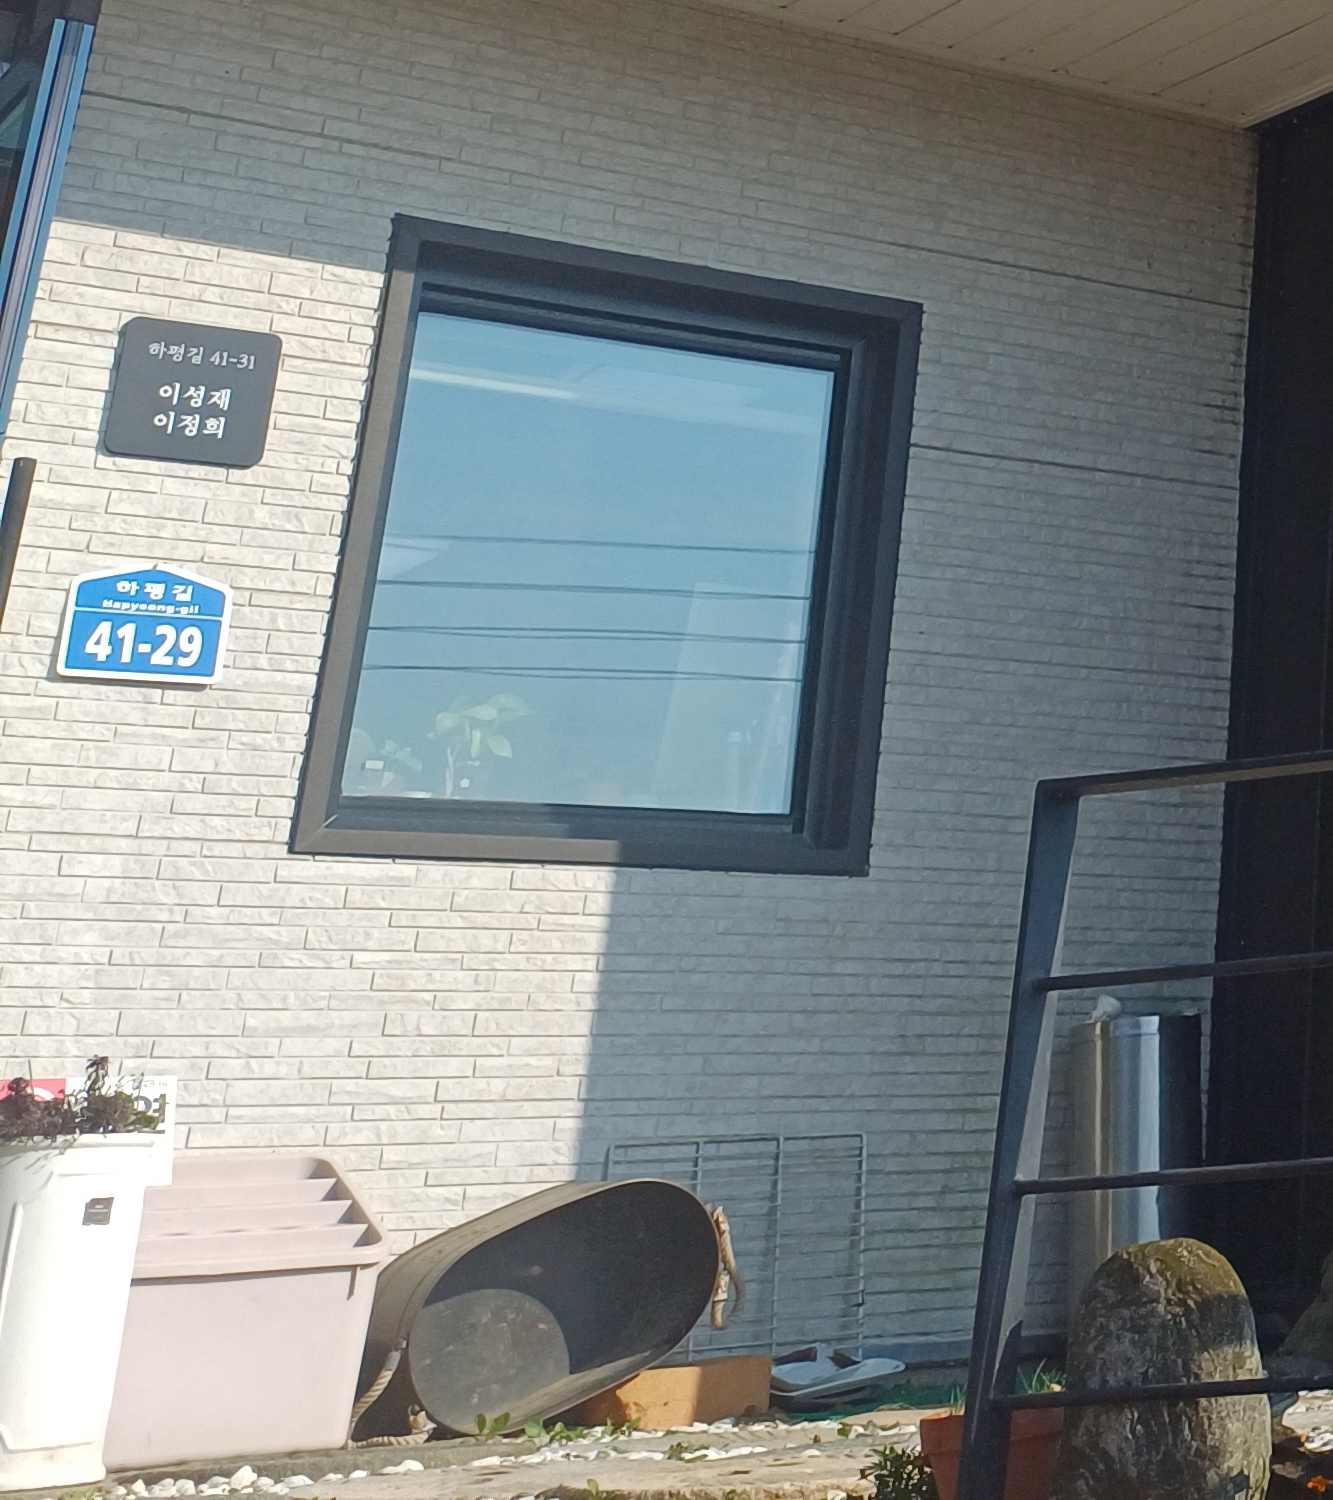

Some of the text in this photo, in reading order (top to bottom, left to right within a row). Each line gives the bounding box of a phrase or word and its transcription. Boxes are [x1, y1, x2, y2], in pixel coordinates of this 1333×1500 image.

[149, 341, 256, 370] 하평길 41-31
[158, 382, 232, 411] 이성재
[153, 410, 226, 439] 이정희
[102, 599, 200, 615] Hapyeong-gil
[84, 621, 203, 667] 41-29
